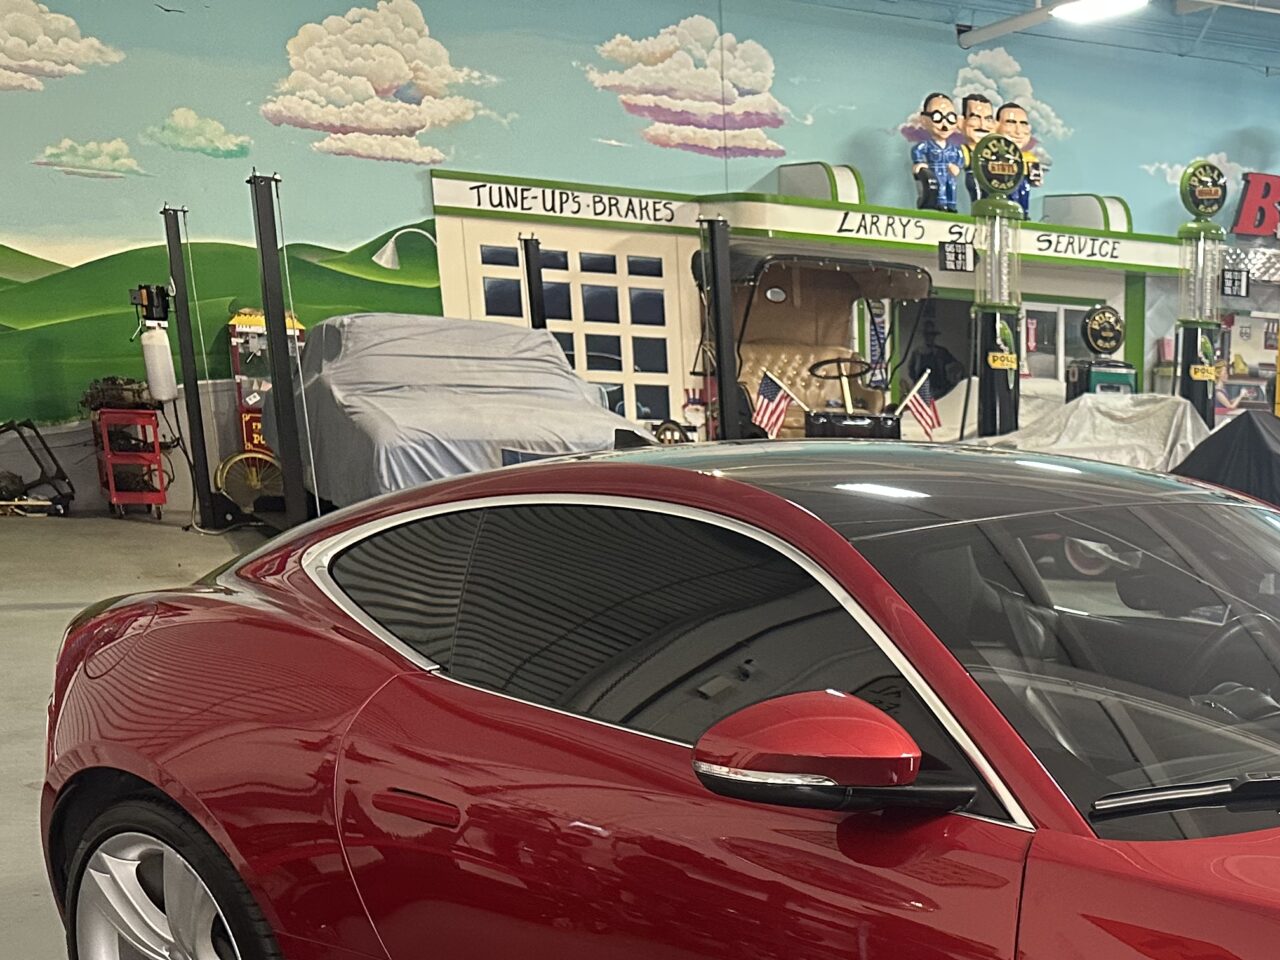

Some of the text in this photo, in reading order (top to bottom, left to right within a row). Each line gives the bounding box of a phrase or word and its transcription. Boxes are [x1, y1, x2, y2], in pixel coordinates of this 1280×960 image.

[982, 139, 1021, 162] POLLY
[991, 179, 1014, 190] GAS
[469, 184, 675, 222] TUNE-UP'S BRAKES
[1037, 232, 1121, 259] SERVICE
[992, 355, 1016, 363] POLL
